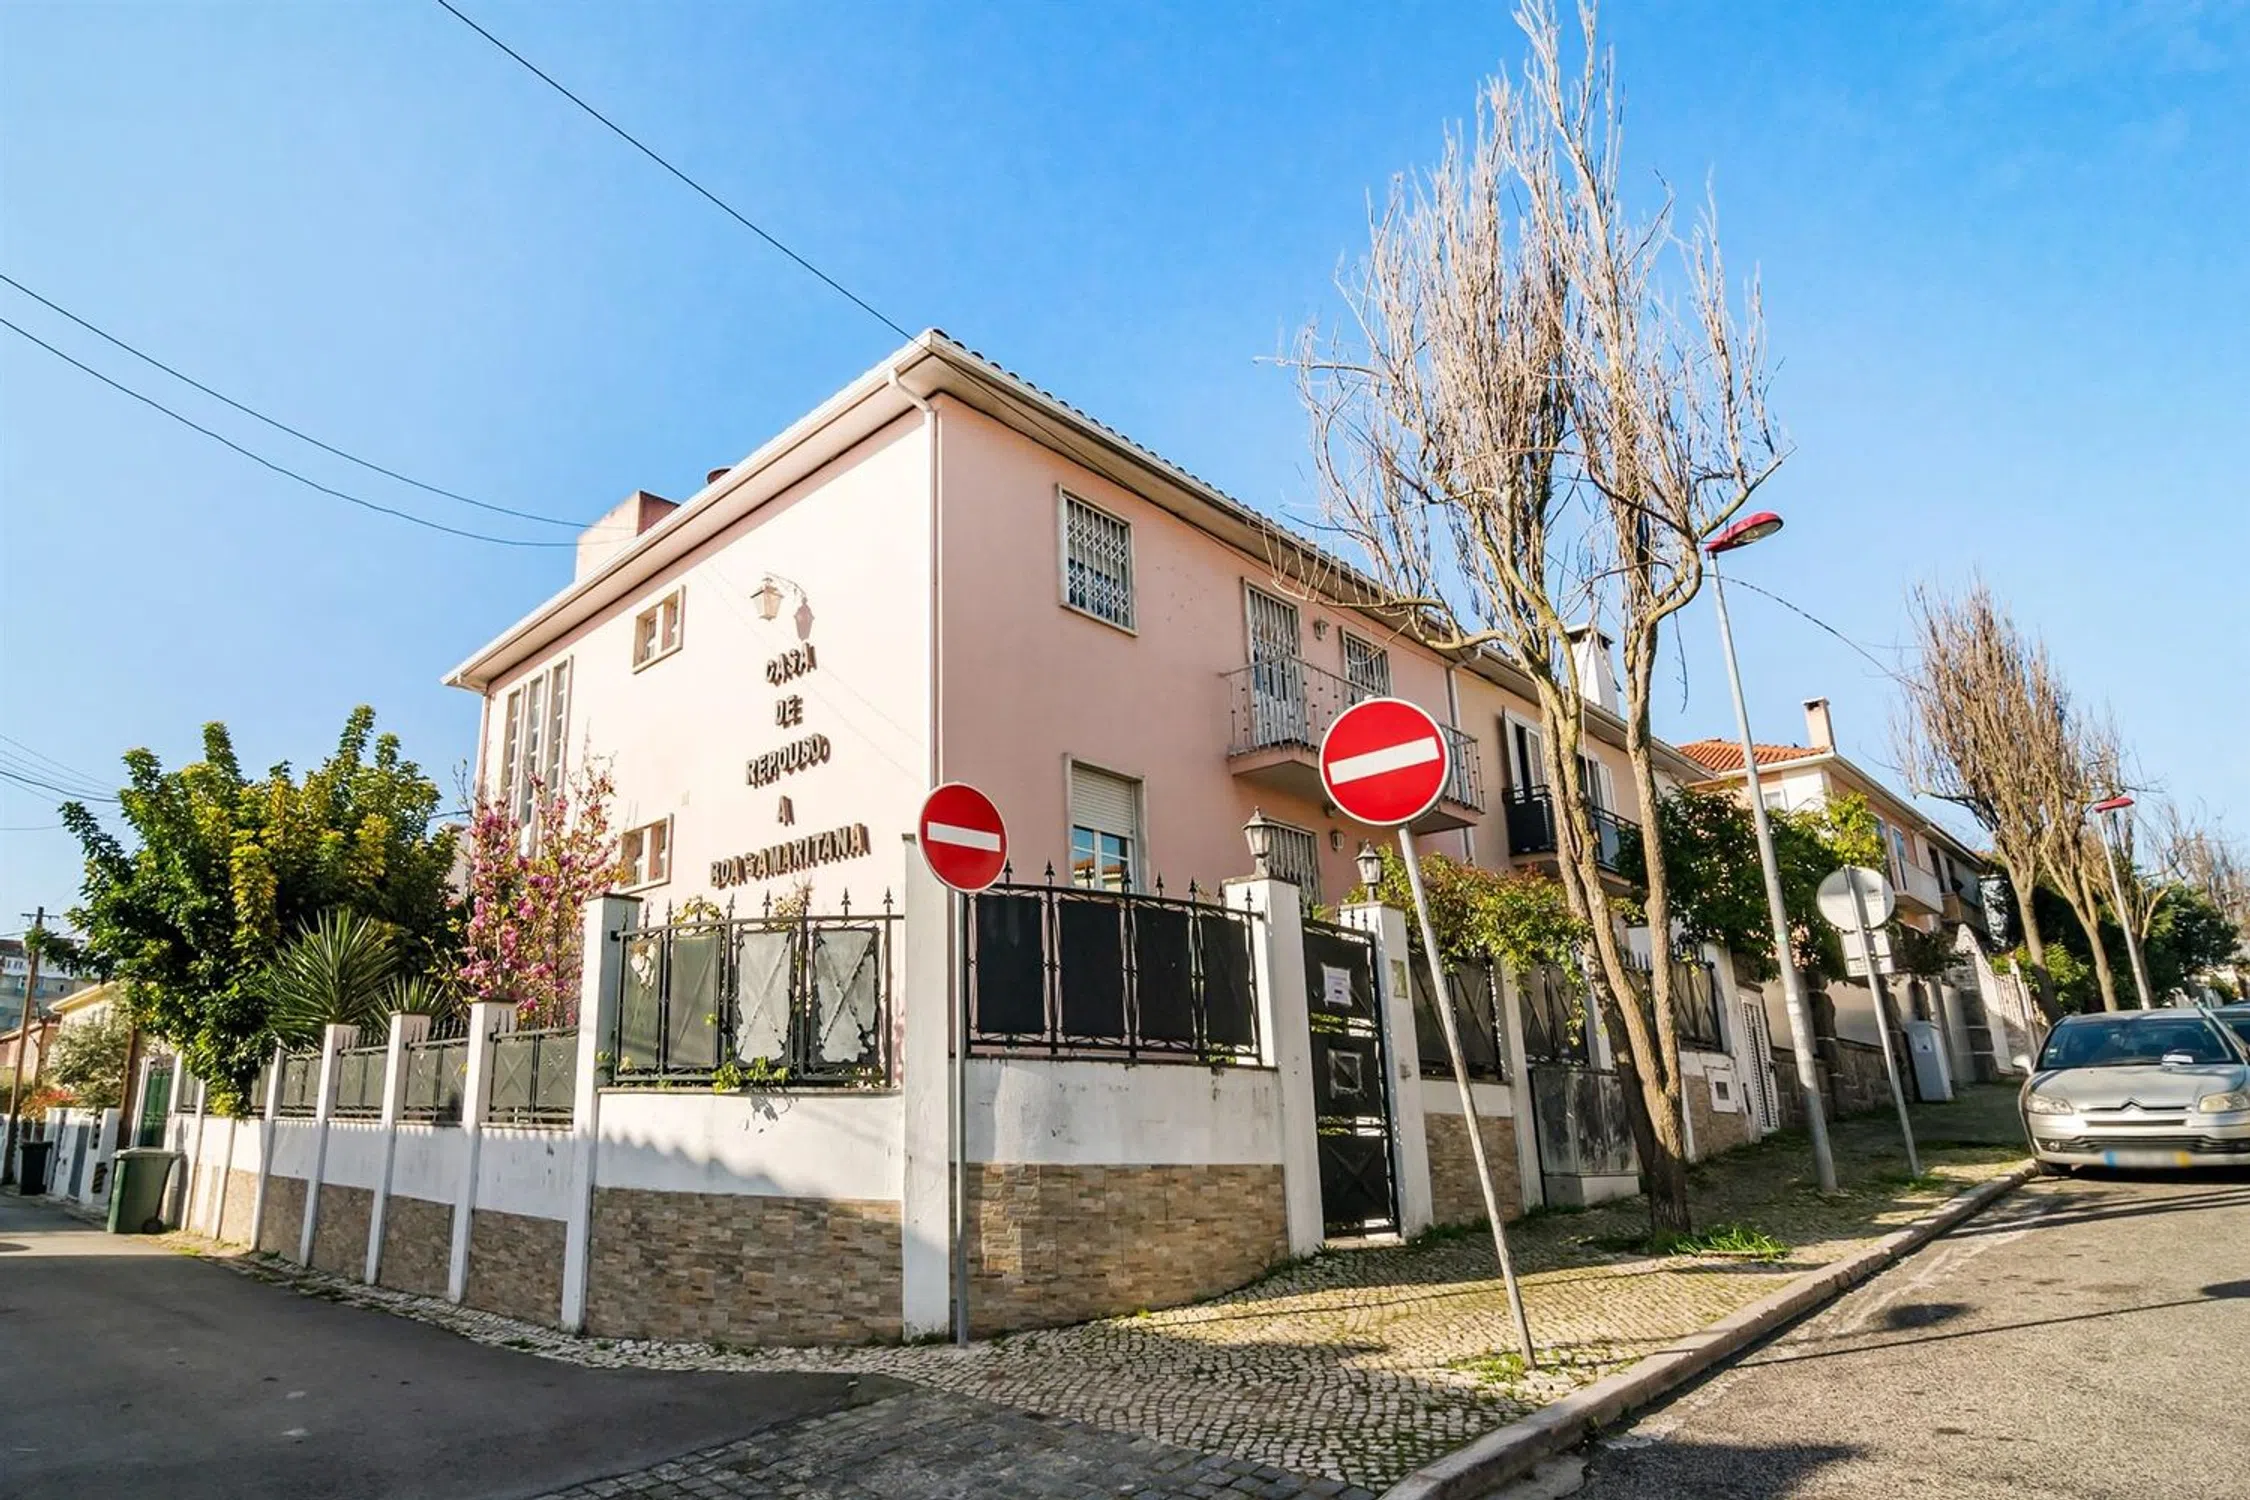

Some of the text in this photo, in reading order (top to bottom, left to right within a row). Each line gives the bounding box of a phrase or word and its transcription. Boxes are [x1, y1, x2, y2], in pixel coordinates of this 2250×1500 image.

[766, 641, 815, 685] CASA
[776, 694, 802, 727] DE
[746, 732, 828, 787] REPOUSO
[777, 795, 793, 825] A
[710, 822, 868, 888] BOA SAMARITANA
